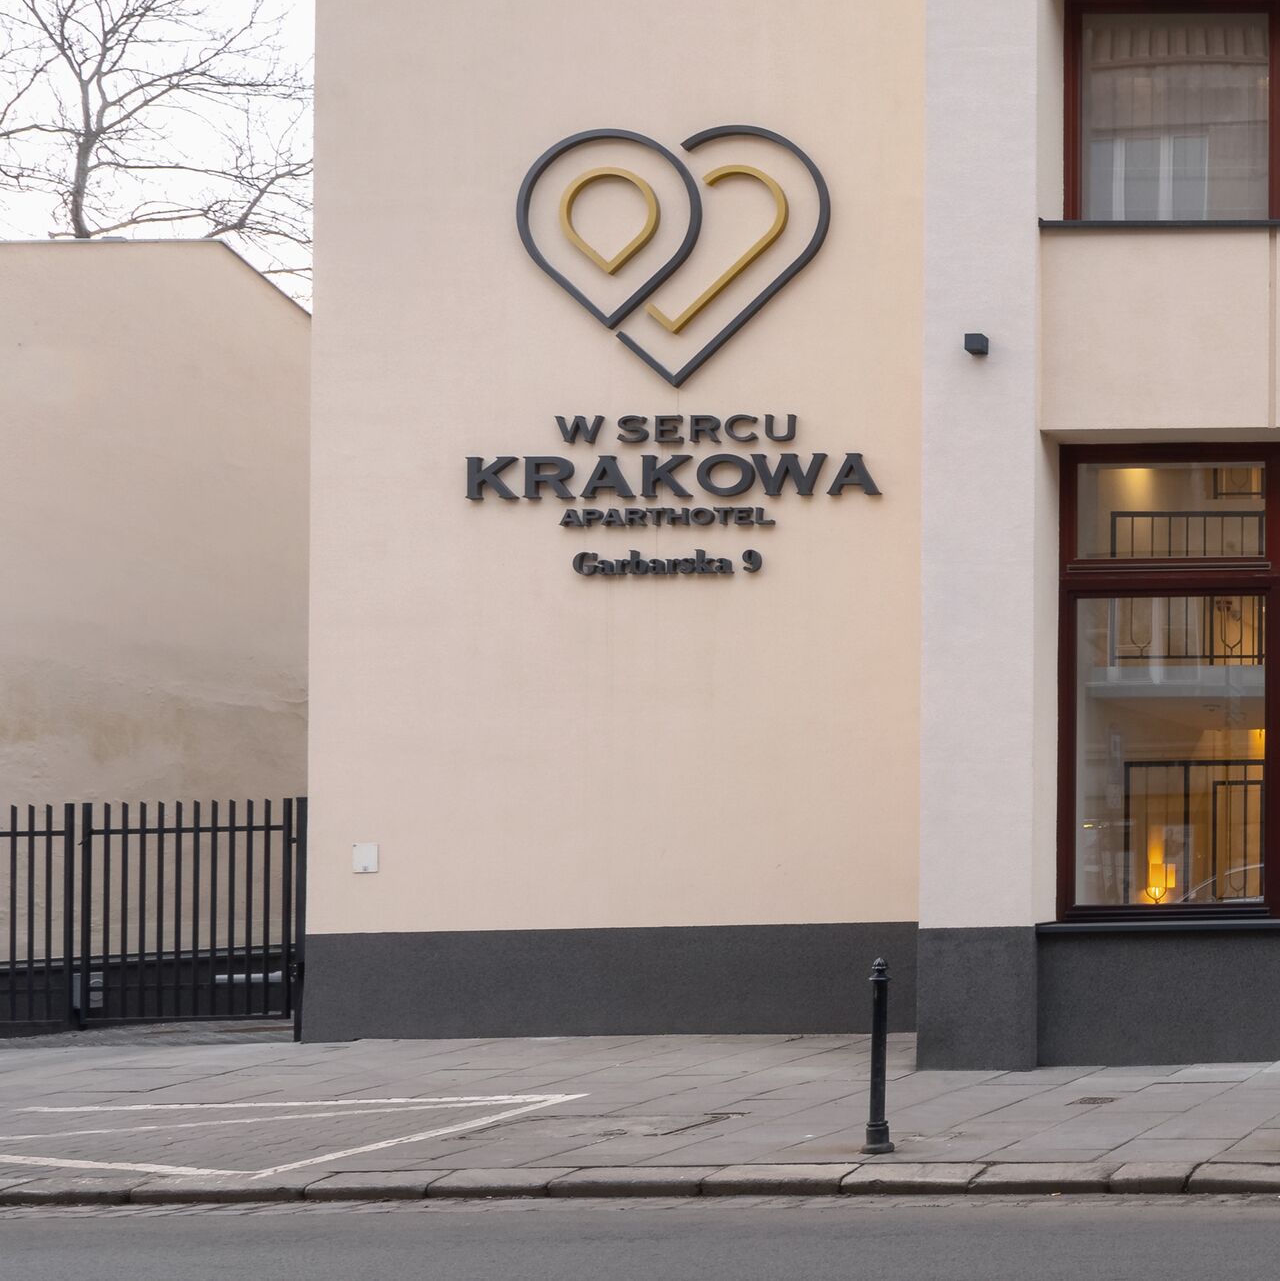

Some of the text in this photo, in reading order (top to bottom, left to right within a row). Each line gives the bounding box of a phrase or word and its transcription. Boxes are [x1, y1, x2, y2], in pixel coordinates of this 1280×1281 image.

[554, 413, 797, 445] W SERCU
[464, 452, 882, 503] KRAKOWA
[559, 506, 776, 528] APARTHOTEL
[572, 548, 763, 577] Garbarska 9
